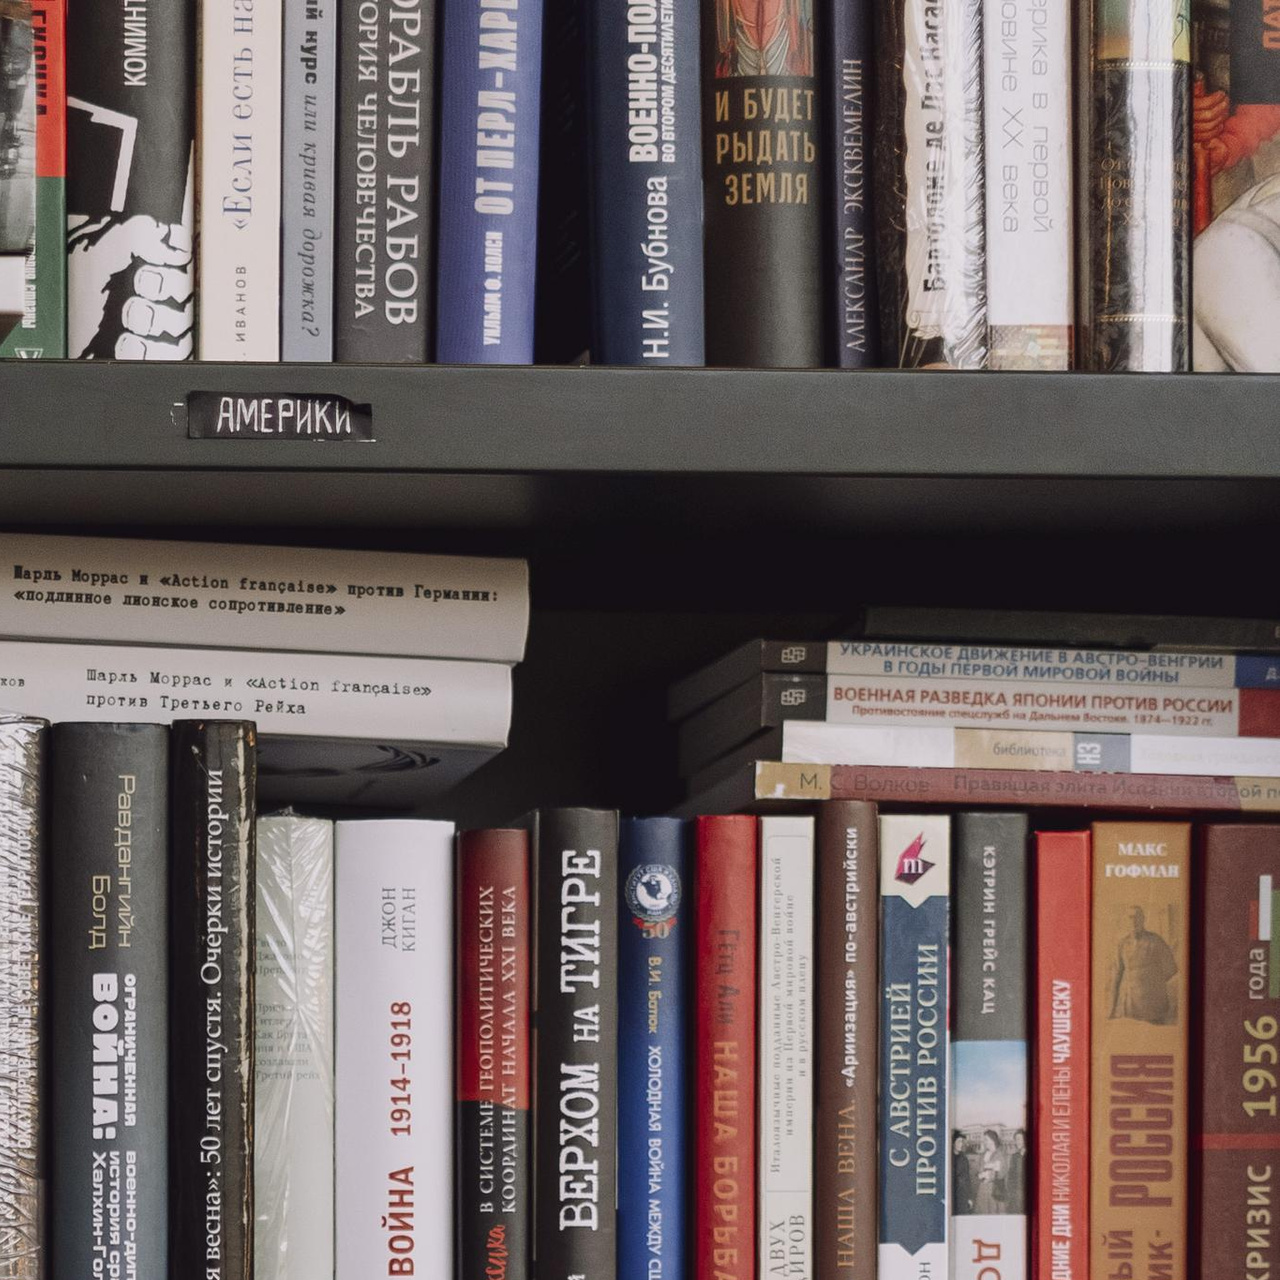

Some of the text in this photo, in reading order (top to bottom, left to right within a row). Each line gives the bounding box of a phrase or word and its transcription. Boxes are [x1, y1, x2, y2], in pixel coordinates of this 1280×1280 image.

[716, 92, 728, 121] И
[716, 131, 815, 163] РЫДАТЬ
[745, 88, 814, 120] БУДЕТ
[354, 92, 377, 318] ЧЕЛОВЕЧЕСТВА
[725, 172, 808, 205] ЗЕМЛЯ
[842, 59, 866, 351] АЛЕКСАНДР ЭКСКВЕМЕЛИН
[384, 174, 419, 325] РАБОВ
[217, 397, 352, 434] АМЕРИКИ
[13, 565, 499, 604] Шарль Моррас и «Action française» против Германии:
[833, 686, 1233, 714] ВОЕННАЯ РАЗВЕДКА ЯПОНИИ ПРОТИВ РОССИИ
[118, 775, 135, 947] Равдангийн
[205, 769, 228, 877] истории
[87, 875, 111, 949] Болд
[201, 885, 228, 985] Очерки
[381, 887, 398, 949] ДЖОН
[401, 887, 417, 952] КИГАН
[1248, 949, 1264, 1000] года
[206, 992, 227, 1082] спустя.
[559, 849, 601, 1230] ВЕРХОМ НА ТИГРЕ
[886, 982, 911, 1167] С АВСТРИЕЙ
[916, 944, 938, 1195] ПРОТИВ РОССИИ
[1242, 1016, 1278, 1118] 1956
[199, 1136, 221, 1164] 50
[206, 1086, 222, 1131] лет
[1109, 1054, 1173, 1207] РОССИЯ
[203, 1170, 221, 1260] весна»:
[381, 1165, 414, 1277] ВОЙНА
